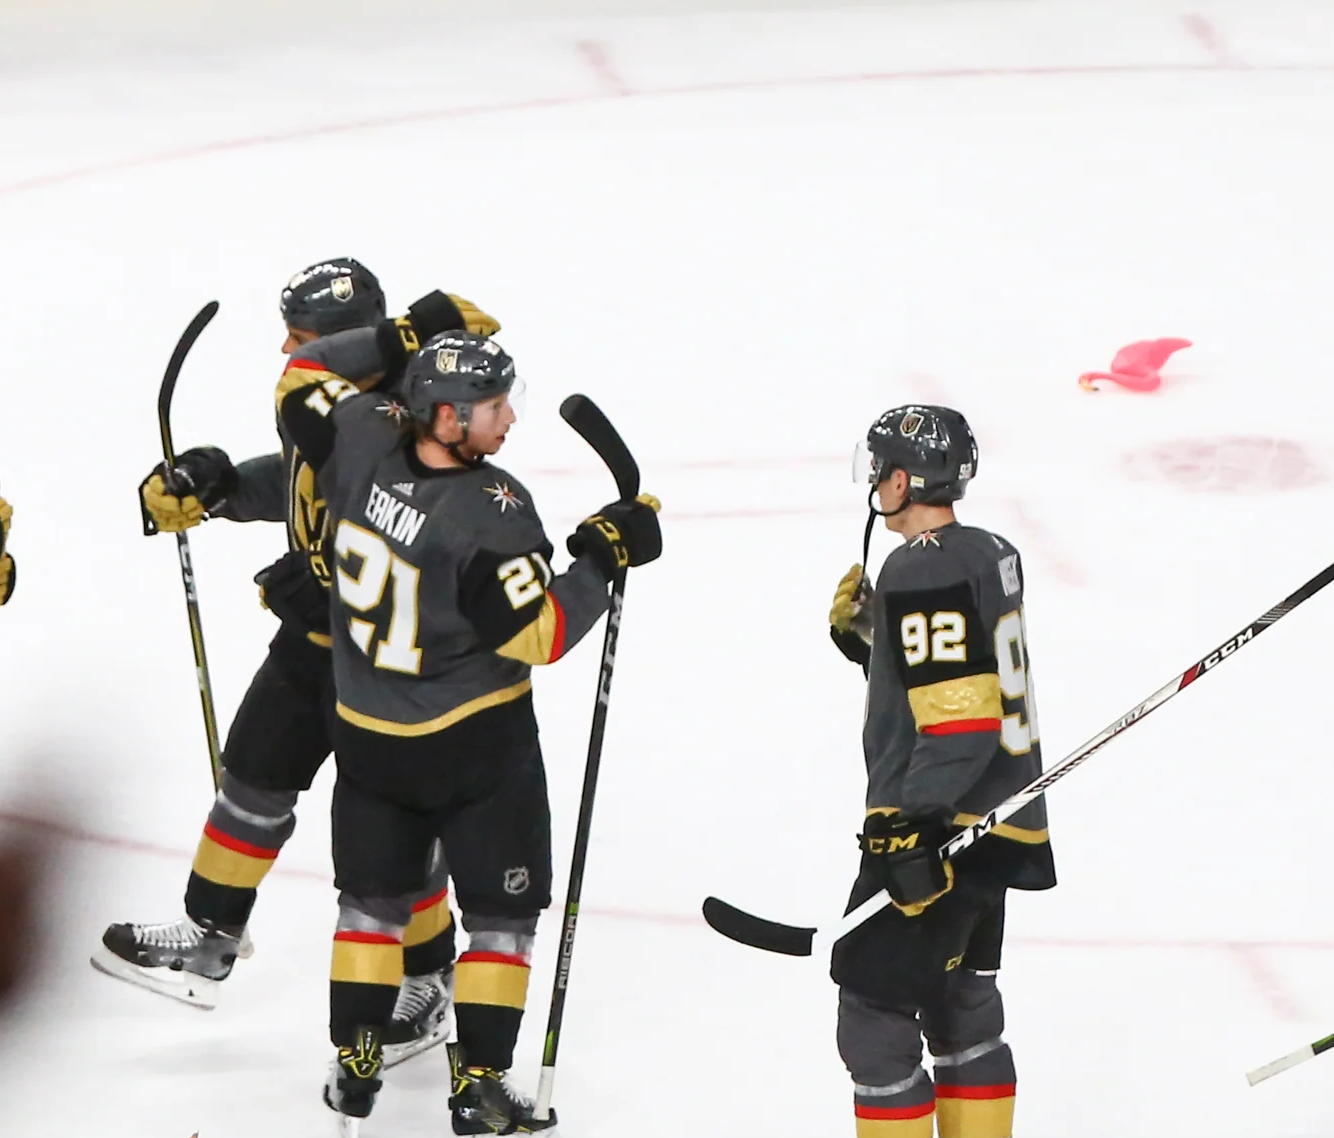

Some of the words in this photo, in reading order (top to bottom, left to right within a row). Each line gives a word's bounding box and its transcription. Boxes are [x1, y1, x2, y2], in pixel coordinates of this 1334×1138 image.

[365, 483, 426, 546] EAKIN
[334, 519, 423, 675] 21
[901, 611, 967, 667] 92
[1204, 627, 1254, 671] CCM
[994, 601, 1040, 756] 9
[869, 832, 920, 855] CM
[941, 811, 997, 860] CM
